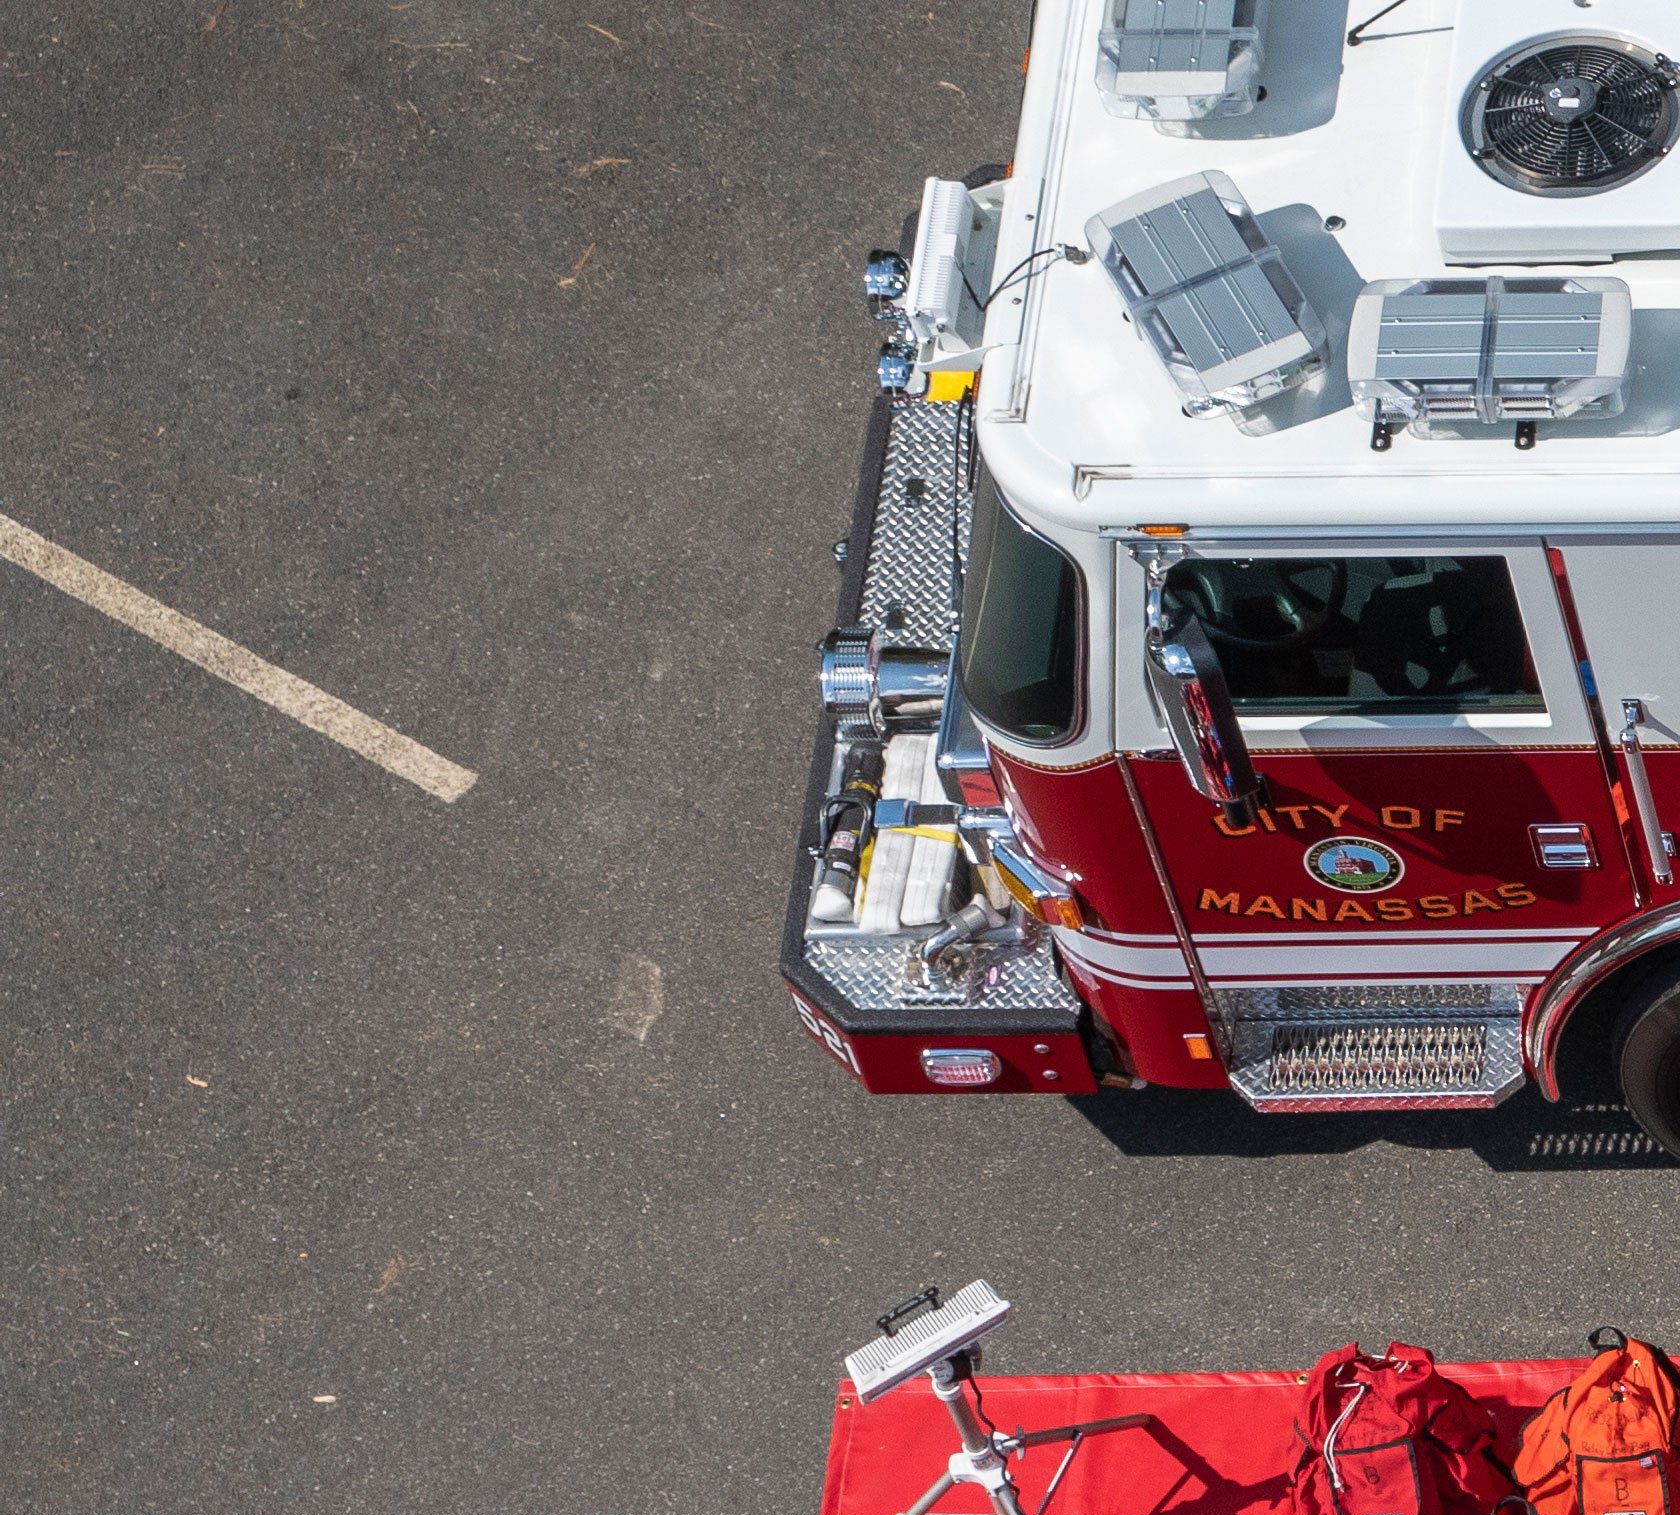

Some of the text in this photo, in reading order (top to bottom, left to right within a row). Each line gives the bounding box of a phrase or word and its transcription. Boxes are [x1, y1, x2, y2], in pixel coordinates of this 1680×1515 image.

[1211, 803, 1467, 838] CITY OF
[1197, 882, 1540, 924] MANASSAS
[787, 992, 862, 1076] 521
[1614, 1477, 1630, 1502] B
